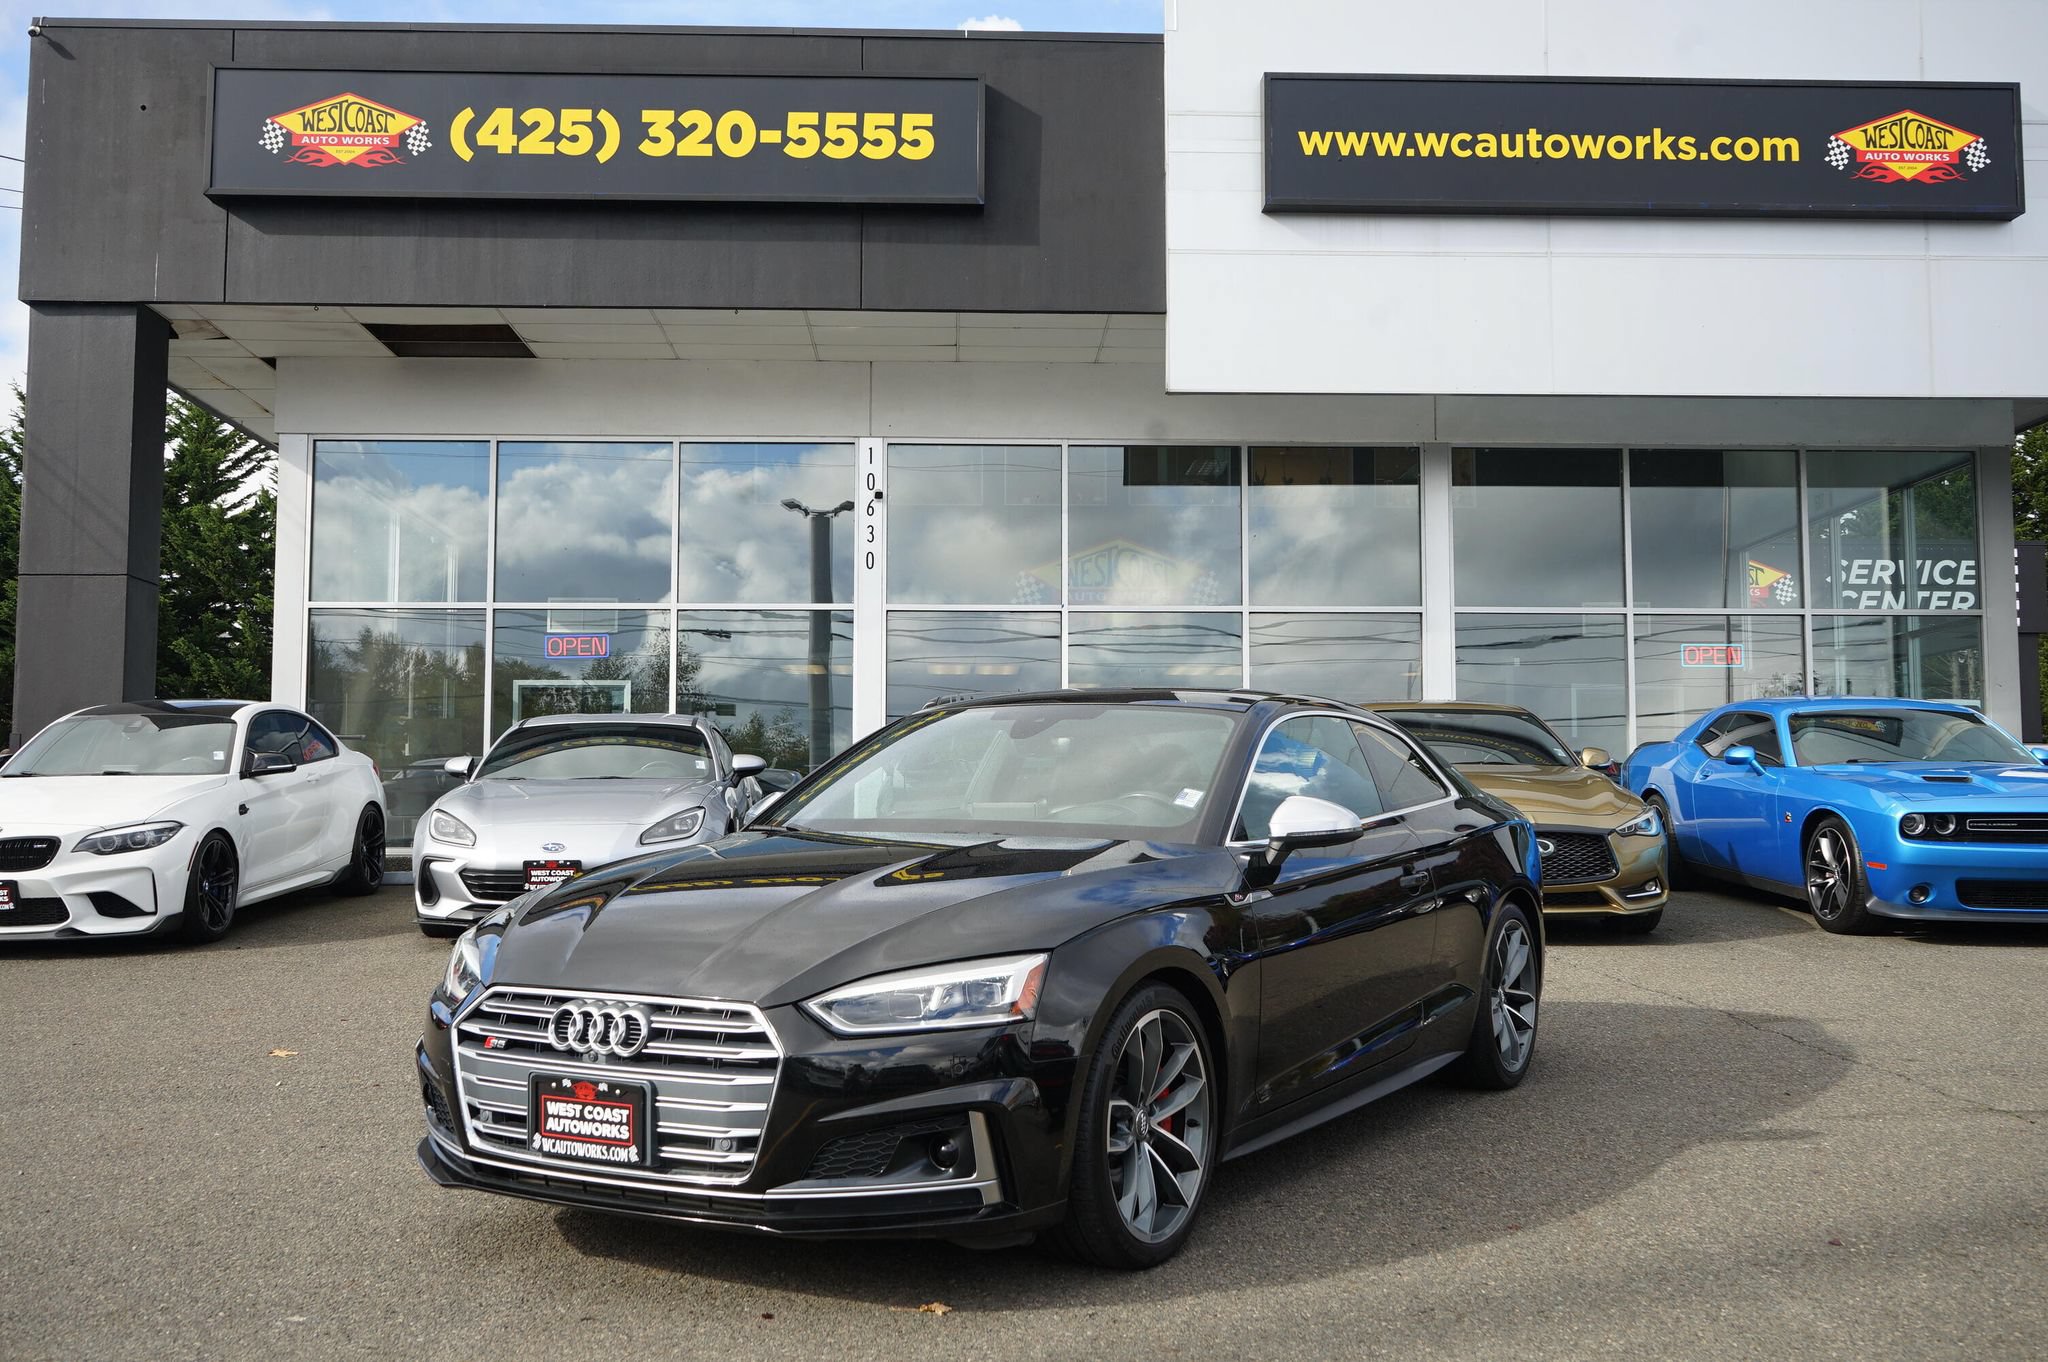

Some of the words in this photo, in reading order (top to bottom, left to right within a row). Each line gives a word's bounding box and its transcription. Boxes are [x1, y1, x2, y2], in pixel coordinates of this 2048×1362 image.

[301, 136, 339, 145] AUTO
[346, 136, 391, 145] WORKS
[450, 106, 620, 164] (425)
[638, 109, 935, 161] 320-5555
[1298, 128, 1800, 162] www.wcautoworks.com
[1865, 152, 1901, 161] AUTO
[1903, 152, 1950, 162] WORKS
[547, 636, 606, 656] OPEN
[1684, 646, 1741, 665] OPEN
[546, 1101, 582, 1118] WEST
[583, 1105, 629, 1123] COAST
[546, 1117, 630, 1140] AUTOWORKS
[541, 1137, 629, 1162] WCAUTOWORKS.COM
